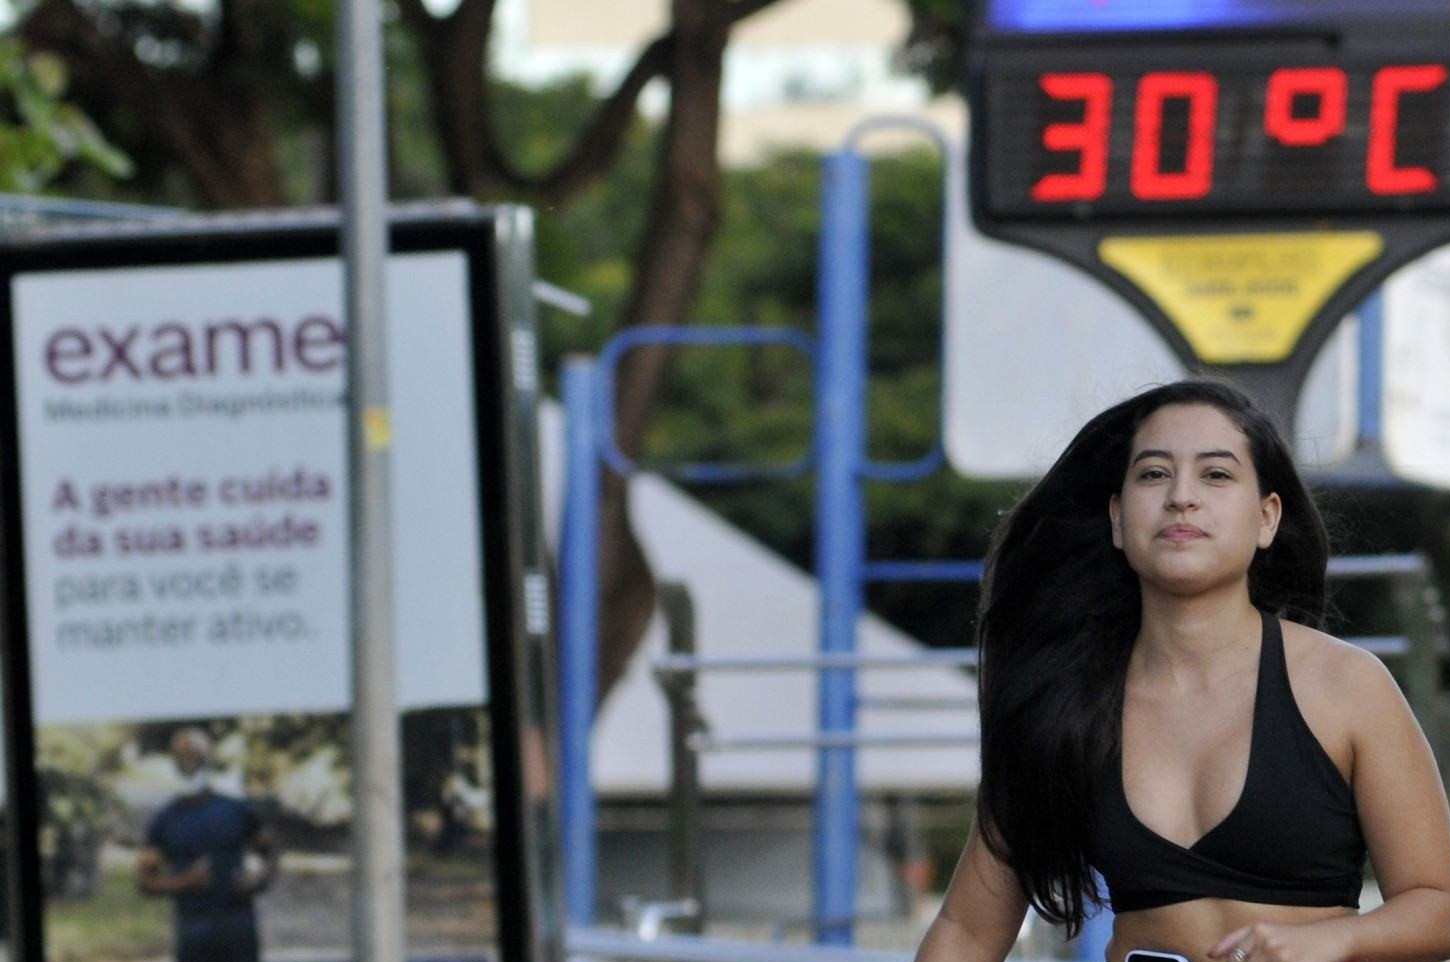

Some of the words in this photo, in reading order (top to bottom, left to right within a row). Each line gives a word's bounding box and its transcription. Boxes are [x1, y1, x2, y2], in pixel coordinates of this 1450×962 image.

[44, 313, 347, 386] exame
[53, 479, 79, 512] A
[92, 479, 207, 519] gente
[218, 469, 331, 505] cuida
[54, 526, 103, 560] da
[114, 527, 186, 558] sua
[199, 514, 321, 552] saúde
[54, 574, 142, 611] para
[152, 563, 242, 601] você
[255, 566, 298, 596] se
[55, 610, 196, 650] manter
